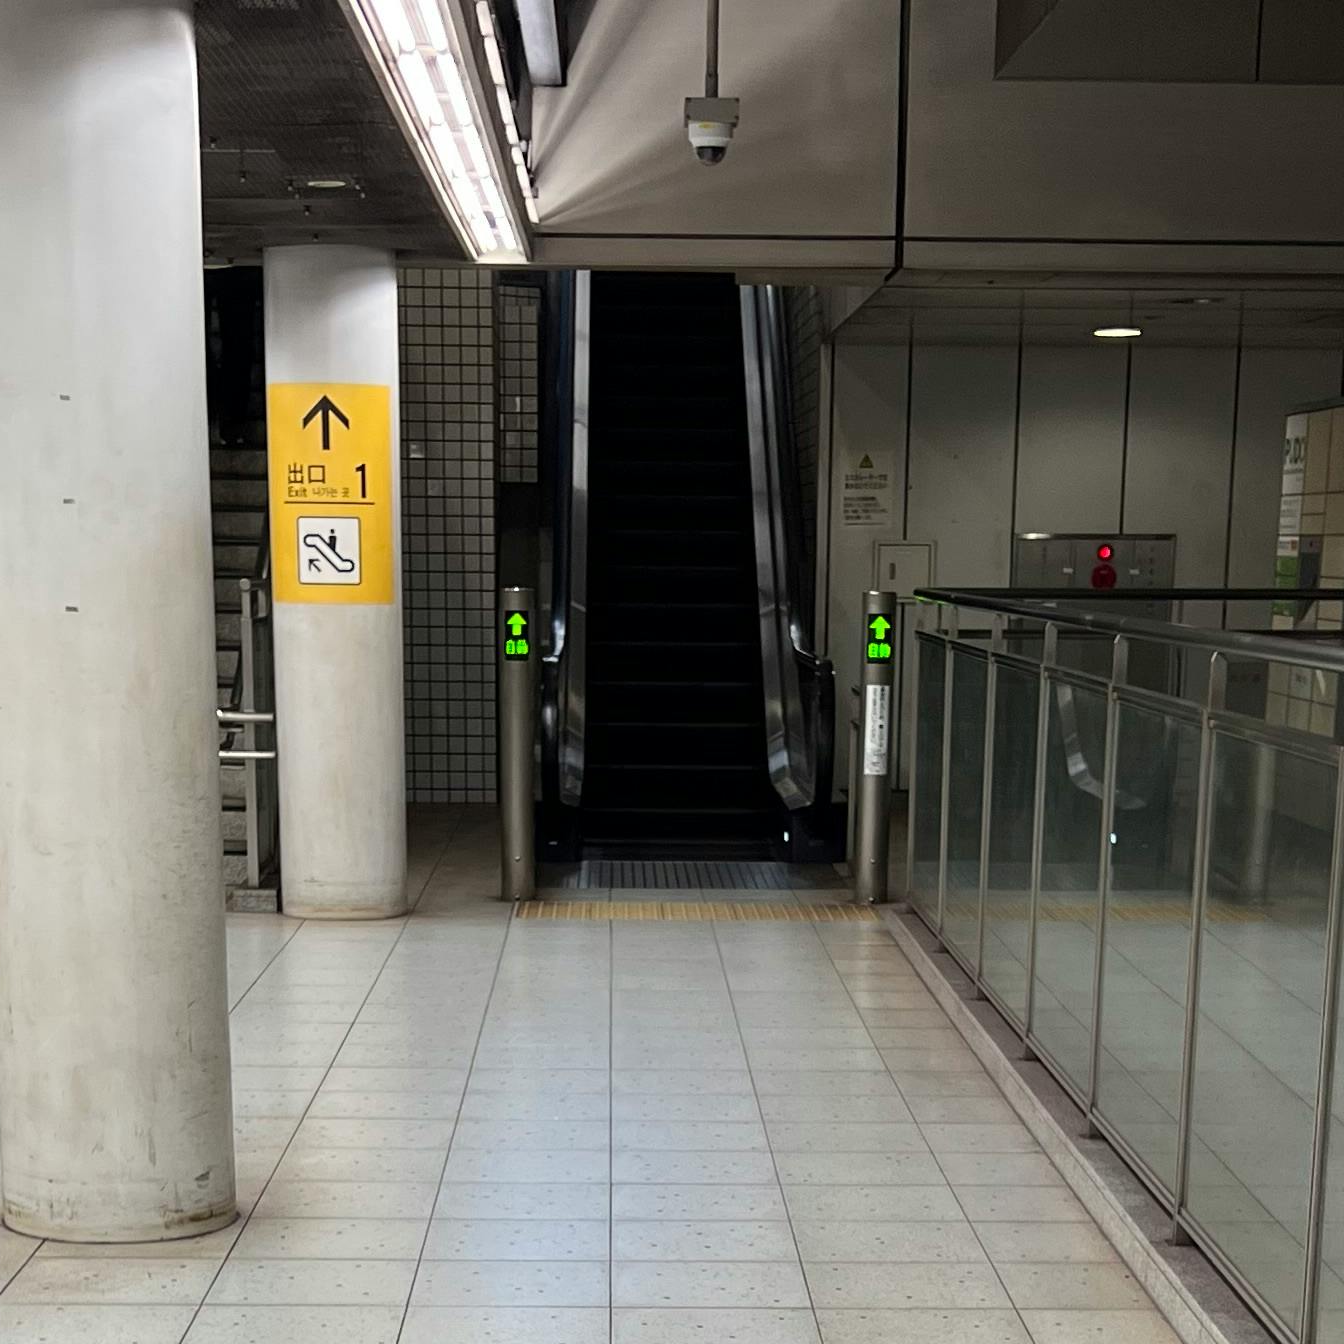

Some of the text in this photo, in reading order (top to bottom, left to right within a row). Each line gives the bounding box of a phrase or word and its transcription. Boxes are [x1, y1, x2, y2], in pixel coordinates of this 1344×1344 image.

[287, 462, 367, 499] 出口 1
[287, 486, 307, 498] Exit
